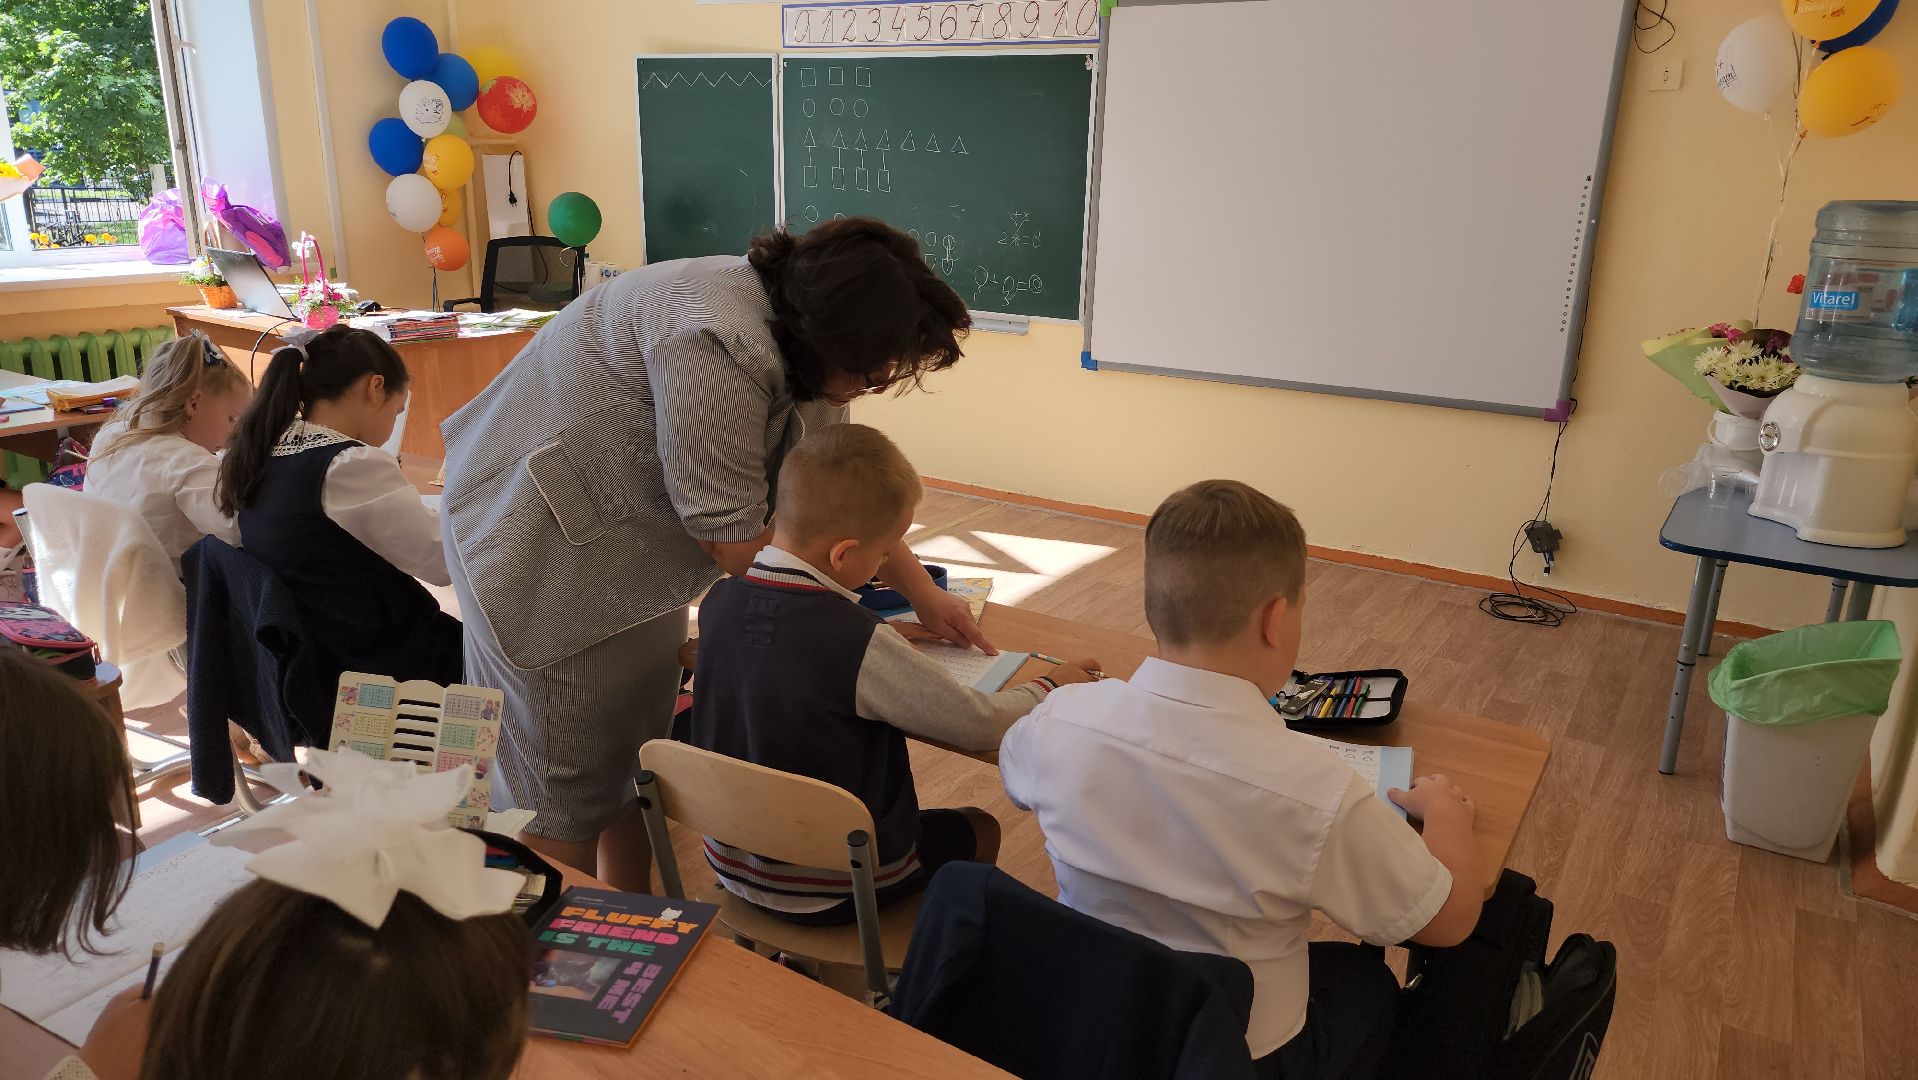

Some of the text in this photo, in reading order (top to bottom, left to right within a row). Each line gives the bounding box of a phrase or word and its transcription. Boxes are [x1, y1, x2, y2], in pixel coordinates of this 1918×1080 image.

[795, 10, 810, 43] 0
[822, 10, 834, 43] 1
[842, 9, 857, 42] 2
[865, 8, 881, 42] 3
[891, 6, 906, 42] 4
[913, 5, 931, 41] 5
[940, 4, 957, 40] 6
[967, 3, 984, 40] 7
[992, 2, 1011, 39] 8
[1019, 1, 1039, 38] 9
[1813, 292, 1856, 305] Vitarel
[549, 918, 680, 945] FRIEND
[561, 906, 699, 934] FLUFFY
[538, 930, 656, 956] IS THE
[596, 978, 631, 1010] ME
[612, 964, 663, 1024] BEST
